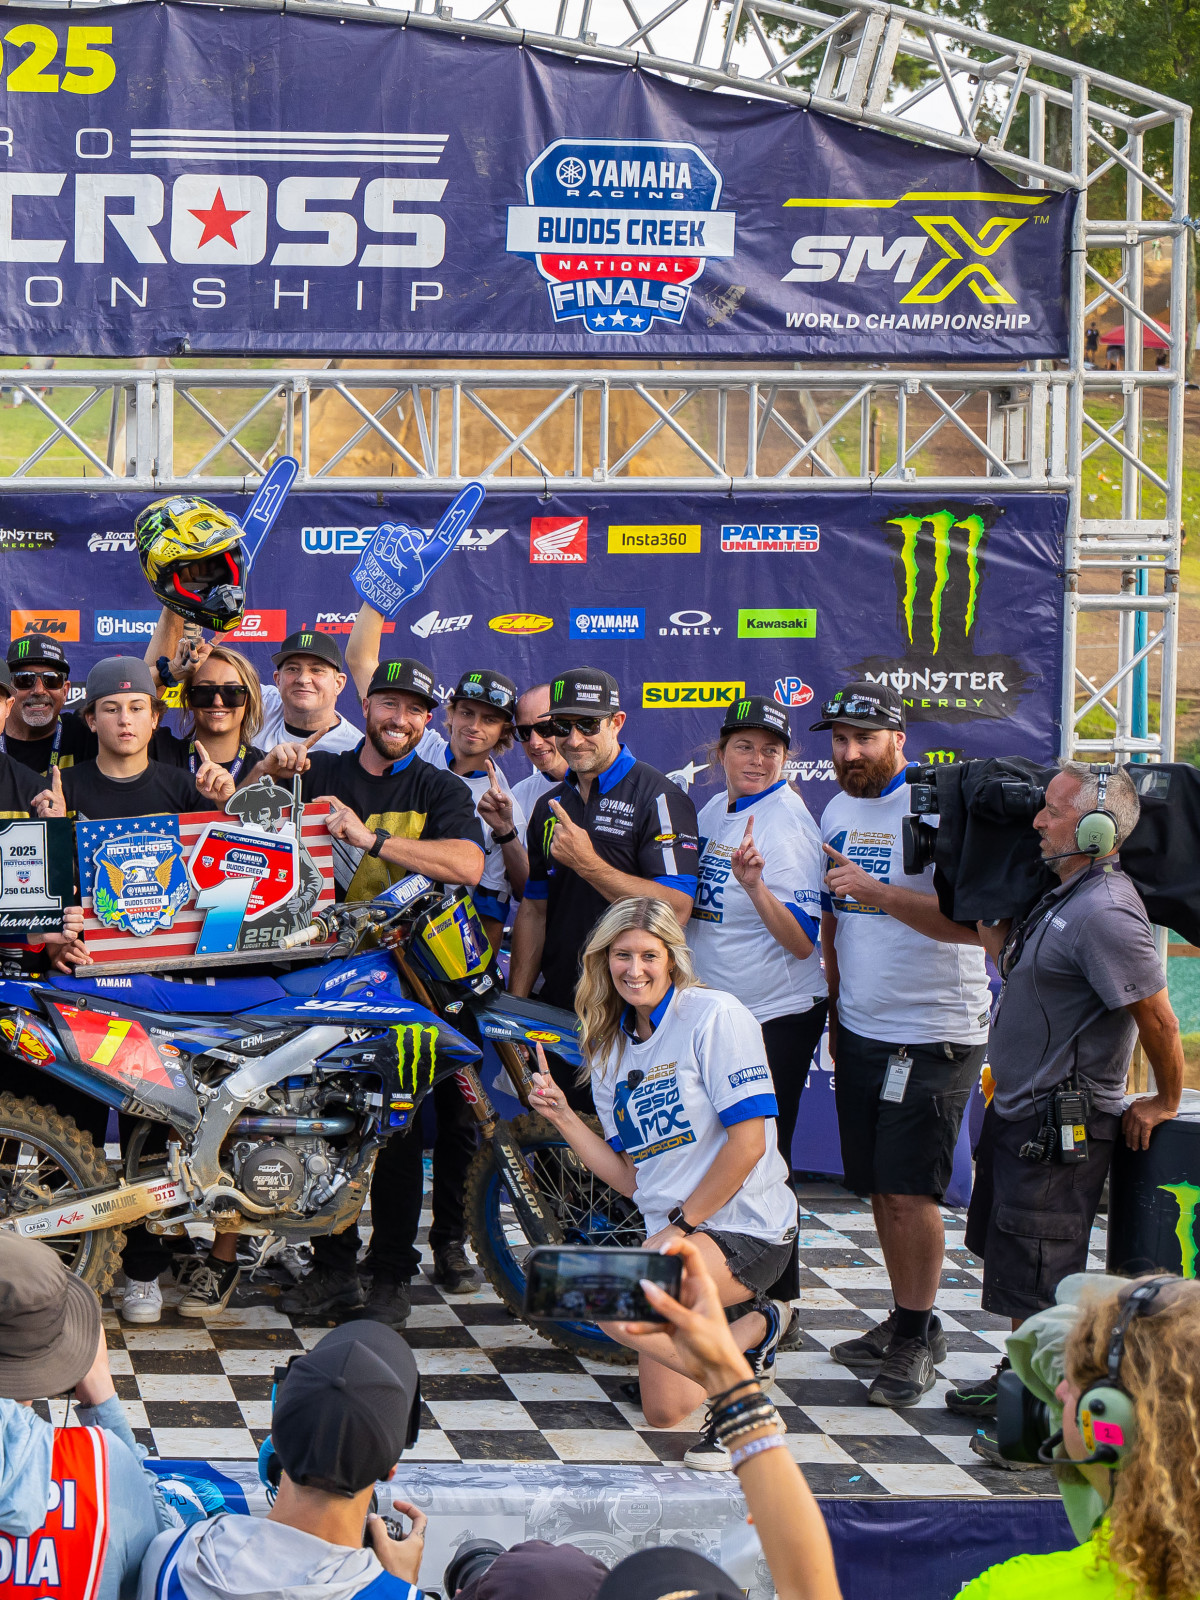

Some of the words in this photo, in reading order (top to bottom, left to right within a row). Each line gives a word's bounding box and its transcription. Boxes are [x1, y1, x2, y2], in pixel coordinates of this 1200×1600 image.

[590, 162, 692, 189] YAMAHA
[567, 190, 683, 199] RACING
[537, 216, 620, 245] BUDDS
[626, 219, 705, 247] CREEK
[559, 260, 683, 272] NATIONAL
[555, 280, 689, 312] FINALS
[785, 313, 862, 330] WORLD
[866, 313, 1031, 331] CHAMPIONSHIP
[254, 484, 280, 522] 1
[439, 510, 465, 545] 1
[722, 525, 818, 541] PARTS
[621, 531, 687, 547] Insta360
[722, 541, 818, 552] UNLIMITED
[533, 553, 582, 562] HONDA
[23, 618, 67, 634] KTM
[435, 615, 473, 628] UFO
[490, 616, 553, 632] FMF
[590, 614, 639, 630] YAMAHA
[747, 617, 807, 630] Kawasaki
[659, 627, 722, 636] OAKLEY
[645, 686, 742, 703] SUZUKI
[903, 698, 983, 708] NERGY
[10, 846, 36, 856] 2025
[107, 843, 173, 855] MOTOCROSS
[847, 847, 891, 857] 2025
[240, 853, 262, 863] YAMAHA
[245, 866, 263, 875] CREEK
[20, 887, 44, 895] CLASS
[134, 885, 158, 893] YAMAHA
[245, 927, 285, 942] 250
[96, 978, 132, 987] YAMAHA
[325, 969, 358, 989] GYTR
[156, 1029, 175, 1038] YAMAHA
[87, 1020, 133, 1066] 1
[240, 1034, 263, 1049] CRM
[738, 1065, 767, 1081] YAMAHA
[632, 1077, 677, 1099] 2025
[635, 1091, 680, 1117] 250
[639, 1104, 691, 1142] MX
[501, 1144, 544, 1219] DUNLOP
[91, 1194, 138, 1215] YAMALUBE
[28, 1223, 46, 1232] AFAM
